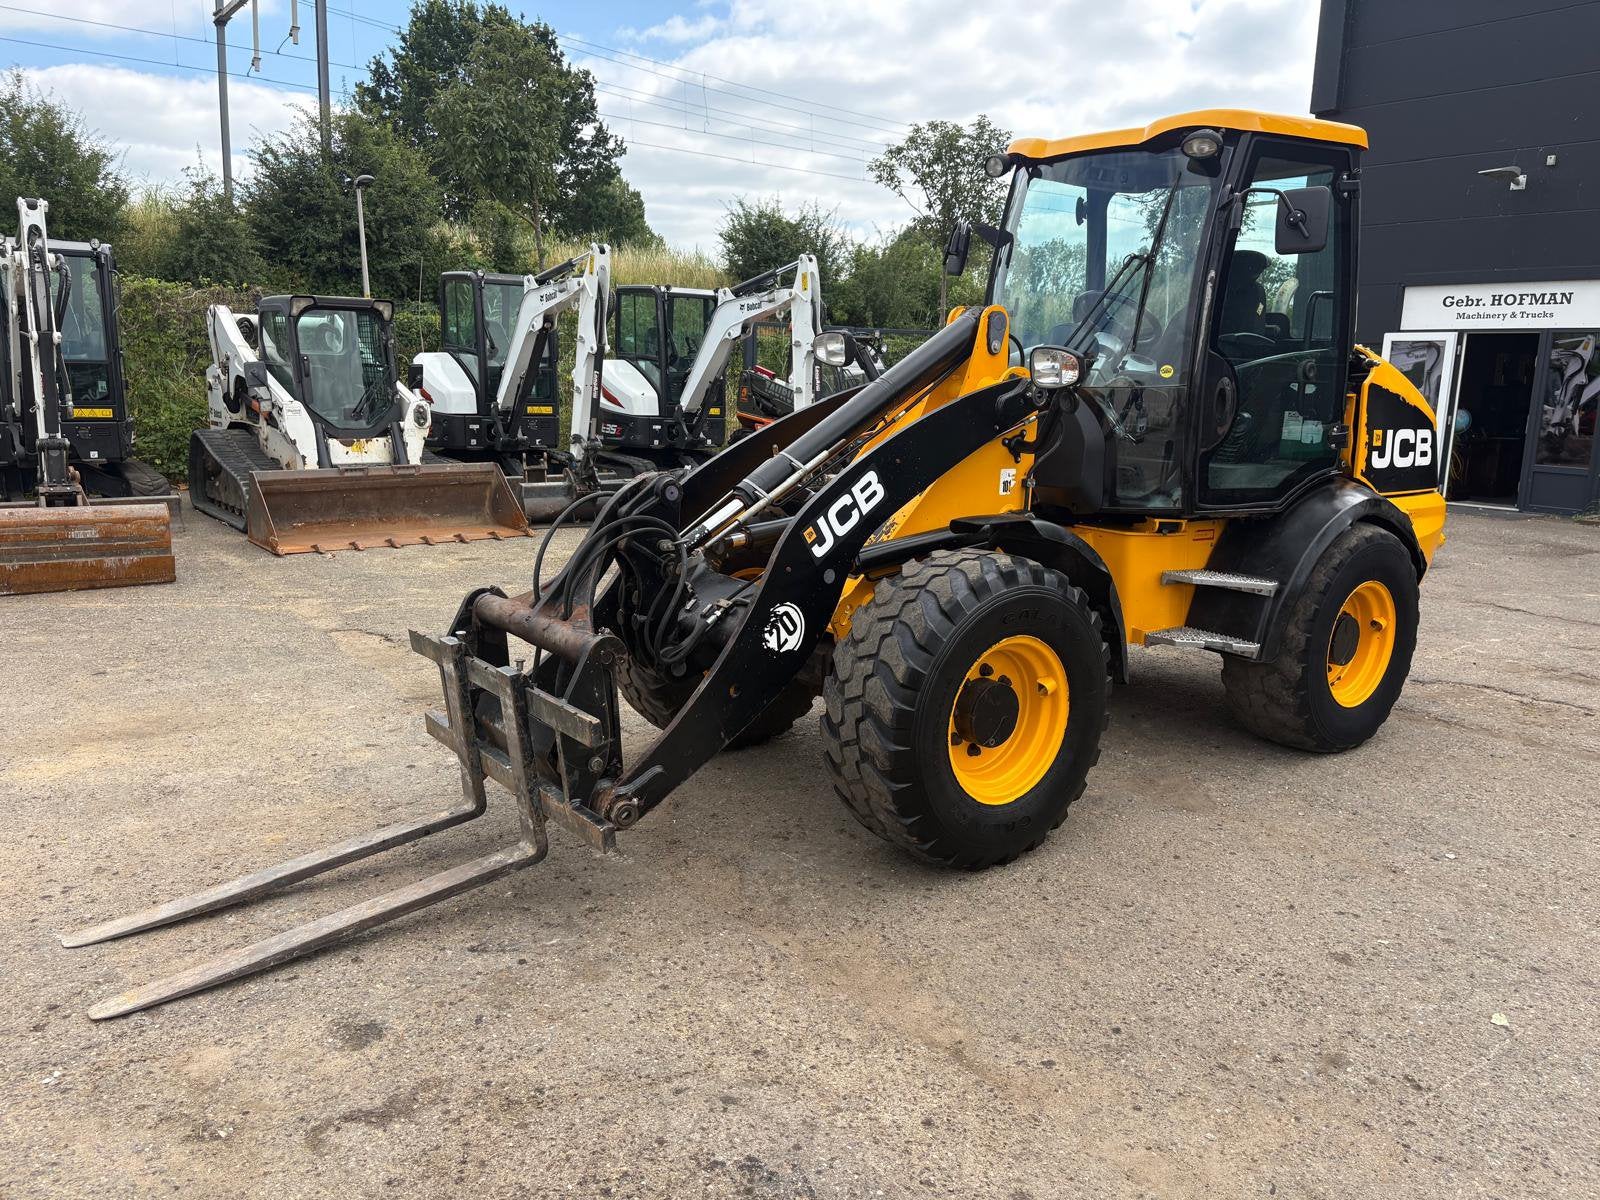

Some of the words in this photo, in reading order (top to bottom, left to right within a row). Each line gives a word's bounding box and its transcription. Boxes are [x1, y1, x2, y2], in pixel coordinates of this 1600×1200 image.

[746, 302, 763, 312] Bobcat
[1442, 294, 1486, 308] Gebr.
[1490, 291, 1574, 306] HOFMAN
[1456, 311, 1508, 321] Machinery
[1519, 310, 1554, 319] Trucks
[1371, 428, 1433, 469] JCB
[811, 470, 885, 558] JCB
[768, 609, 799, 652] 20
